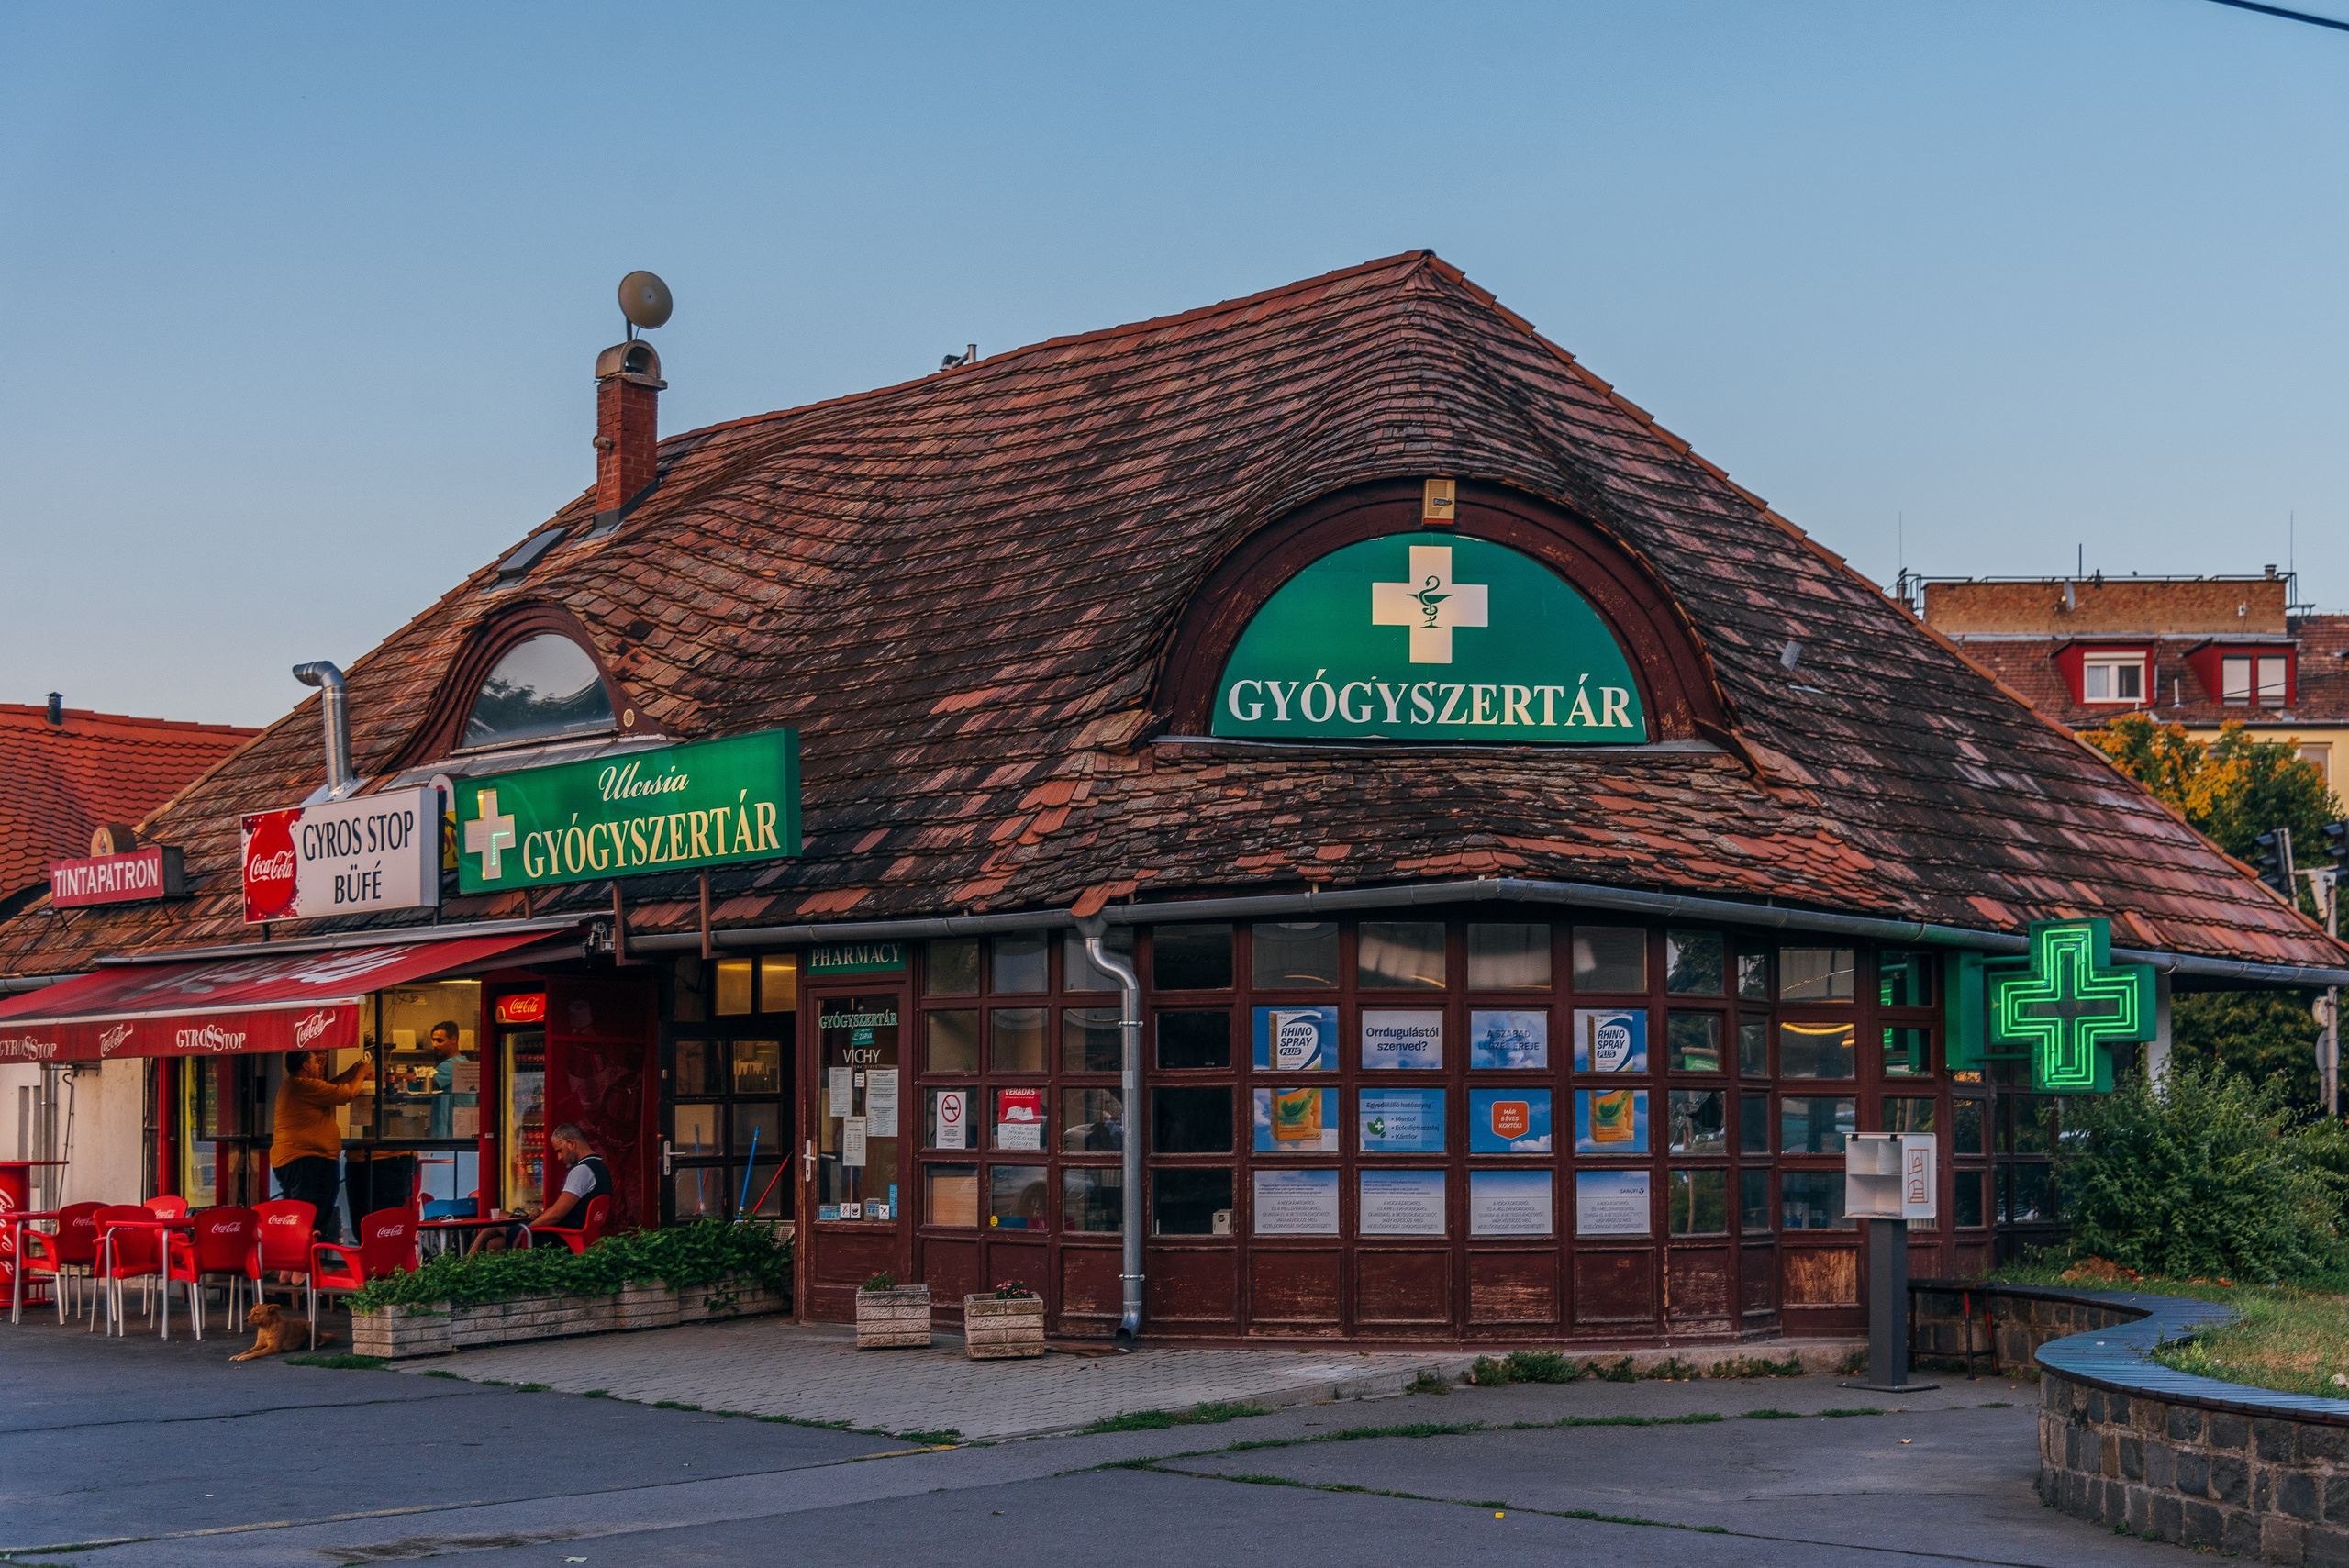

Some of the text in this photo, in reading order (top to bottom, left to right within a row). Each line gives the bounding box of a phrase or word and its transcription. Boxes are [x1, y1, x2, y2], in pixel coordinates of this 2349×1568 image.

[1228, 668, 1634, 728] GYÓGYSZERTÁR
[303, 817, 362, 862] GYROS
[368, 810, 414, 854] STOP
[522, 788, 781, 879] GYÓGYSZERTÁR
[249, 850, 295, 883] Coca-Cola
[54, 858, 159, 898] TINTAPATRON
[334, 860, 383, 905] BÜFÉ
[811, 942, 901, 967] PHARMACY
[818, 1008, 898, 1029] GYÓGYSZERTÁR
[1280, 1037, 1313, 1047] SPRAY
[1281, 1026, 1313, 1037] RHINO
[1365, 1026, 1440, 1040] Orrdugulástól
[1598, 1029, 1626, 1040] RHINO
[1376, 1040, 1428, 1051] szenved?
[1597, 1040, 1626, 1050] SPRAY
[842, 1049, 882, 1064] VICHY
